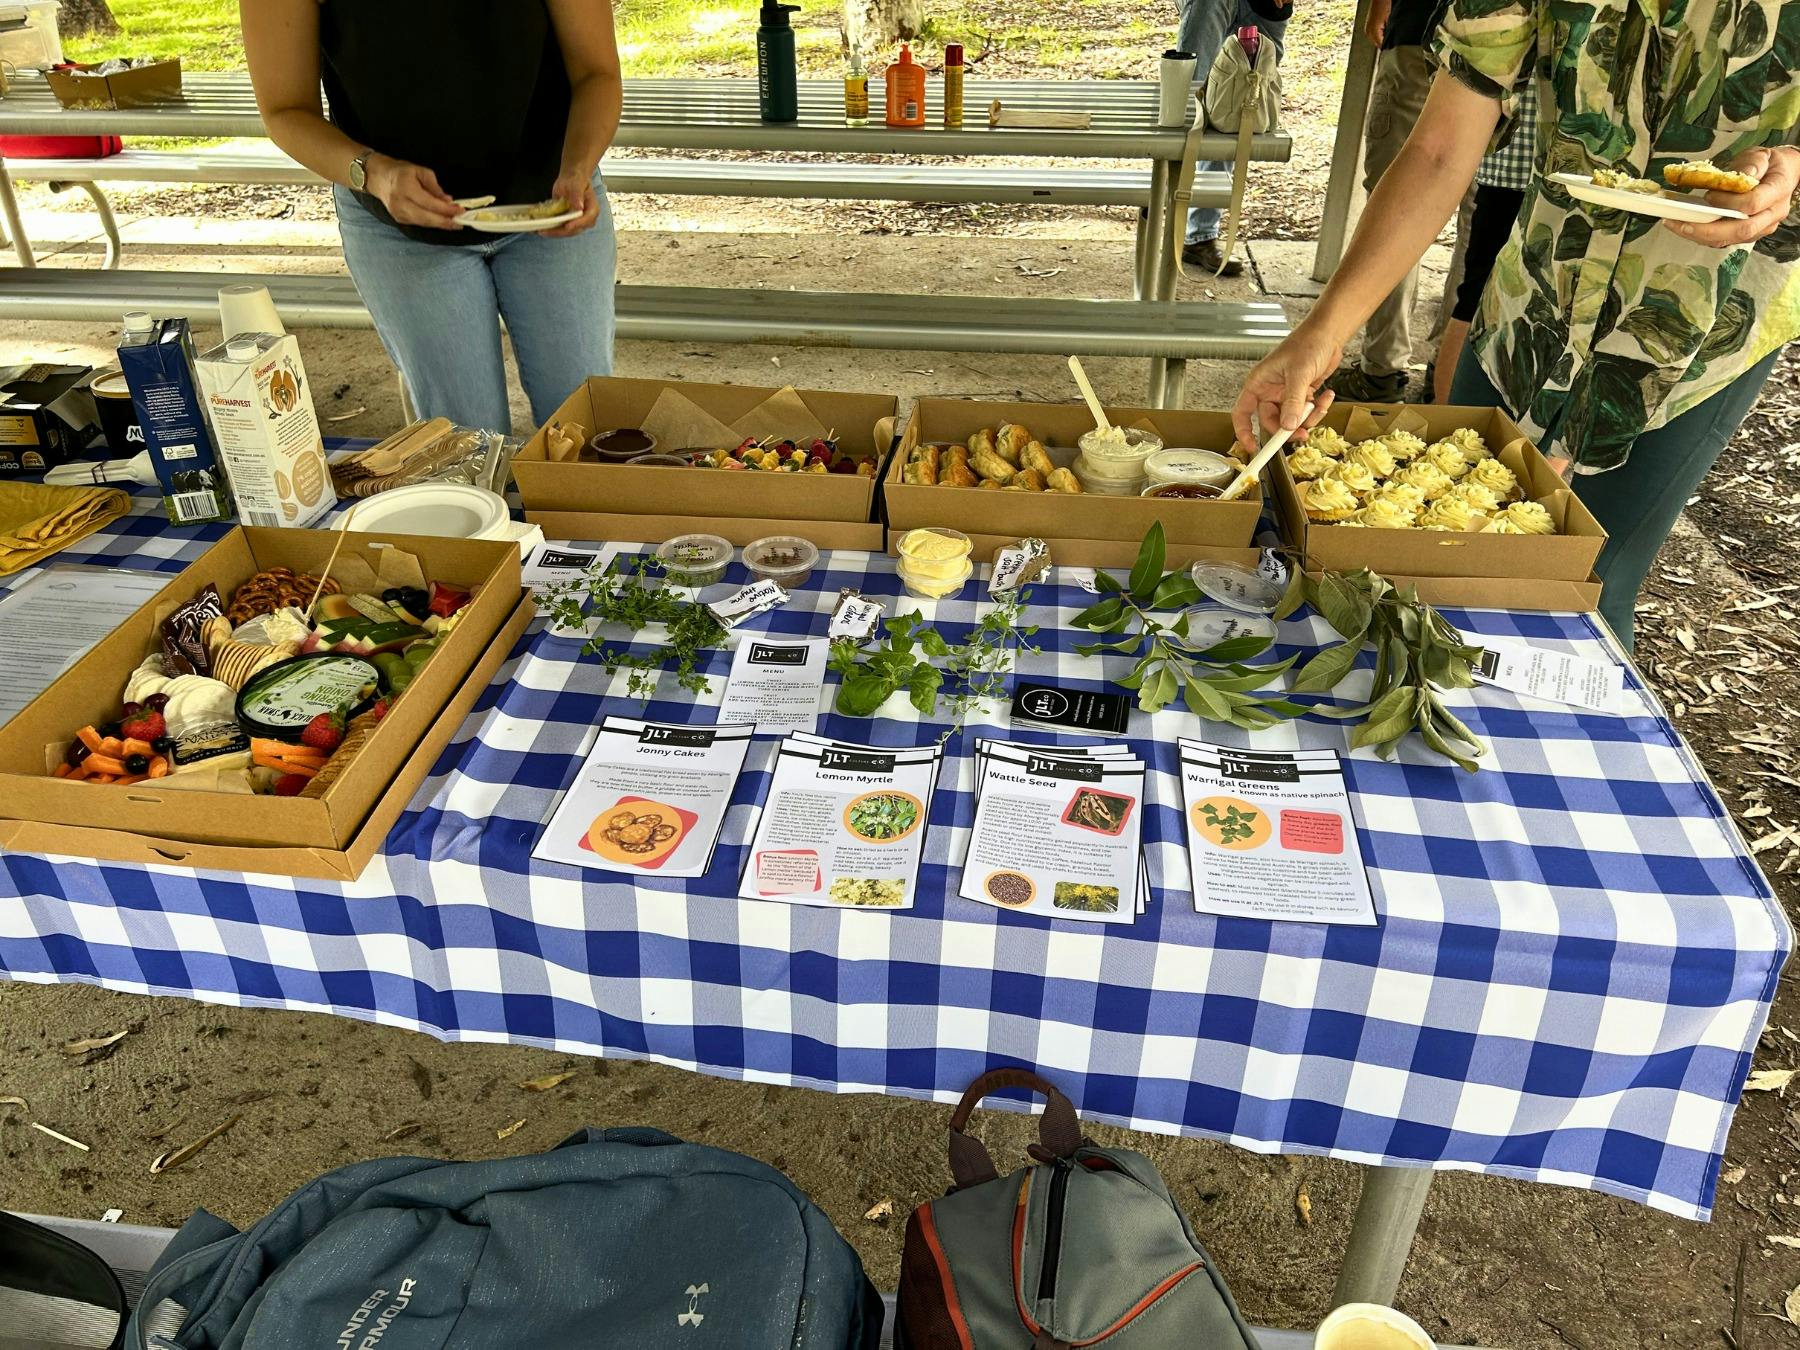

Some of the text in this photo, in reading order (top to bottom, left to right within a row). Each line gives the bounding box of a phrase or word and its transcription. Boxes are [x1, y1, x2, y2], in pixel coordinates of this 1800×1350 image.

[210, 396, 251, 408] PUREHARVEST
[0, 462, 20, 470] COF
[314, 686, 352, 697] ONION
[303, 692, 342, 704] SPRING
[1035, 700, 1052, 715] JLT
[644, 729, 672, 740] JLT
[636, 746, 706, 757] Jonny Cakes
[823, 753, 850, 765] JLT
[1030, 759, 1057, 772] JLT
[1224, 762, 1250, 775] JLT
[816, 772, 893, 784] Lemon Myrtle
[989, 771, 1057, 788] Wattle Seed
[1188, 774, 1280, 791] Warrigal Greens
[1310, 791, 1344, 800] spinach
[358, 1278, 417, 1350] RMOUR
